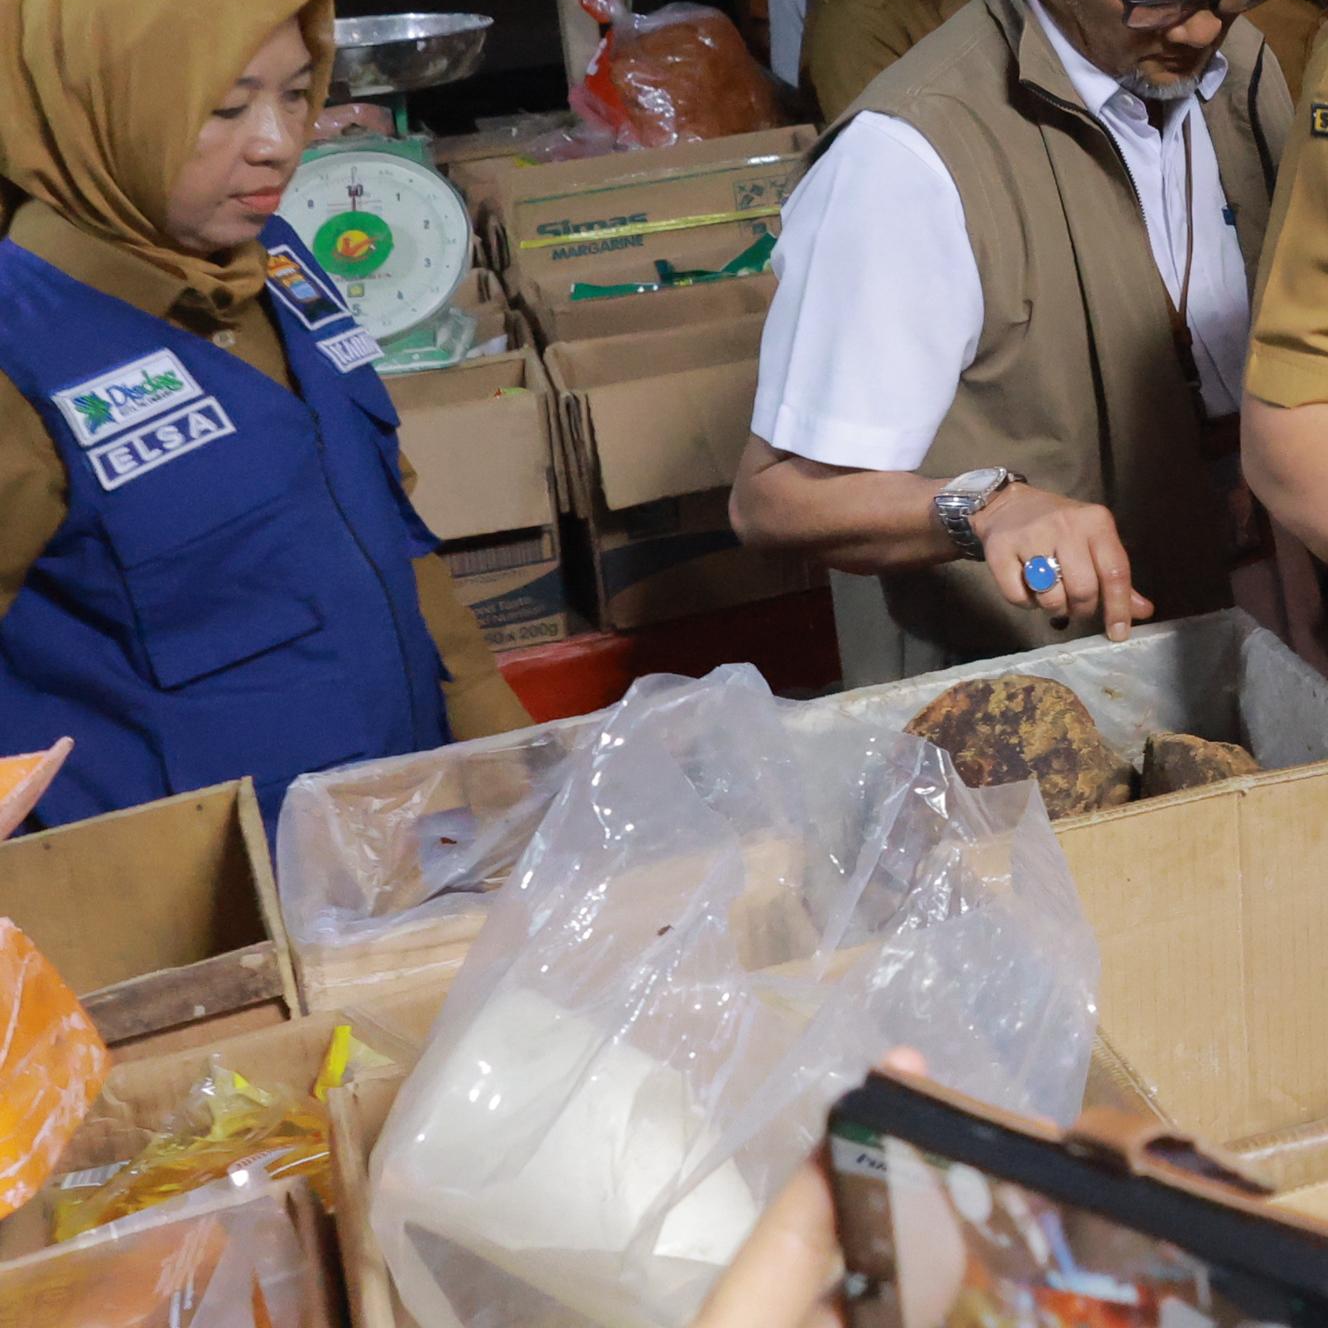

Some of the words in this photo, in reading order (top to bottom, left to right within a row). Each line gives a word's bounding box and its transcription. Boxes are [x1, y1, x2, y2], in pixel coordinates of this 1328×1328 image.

[346, 184, 364, 197] 10
[552, 234, 645, 260] MARGARINE
[107, 411, 218, 474] ELSA
